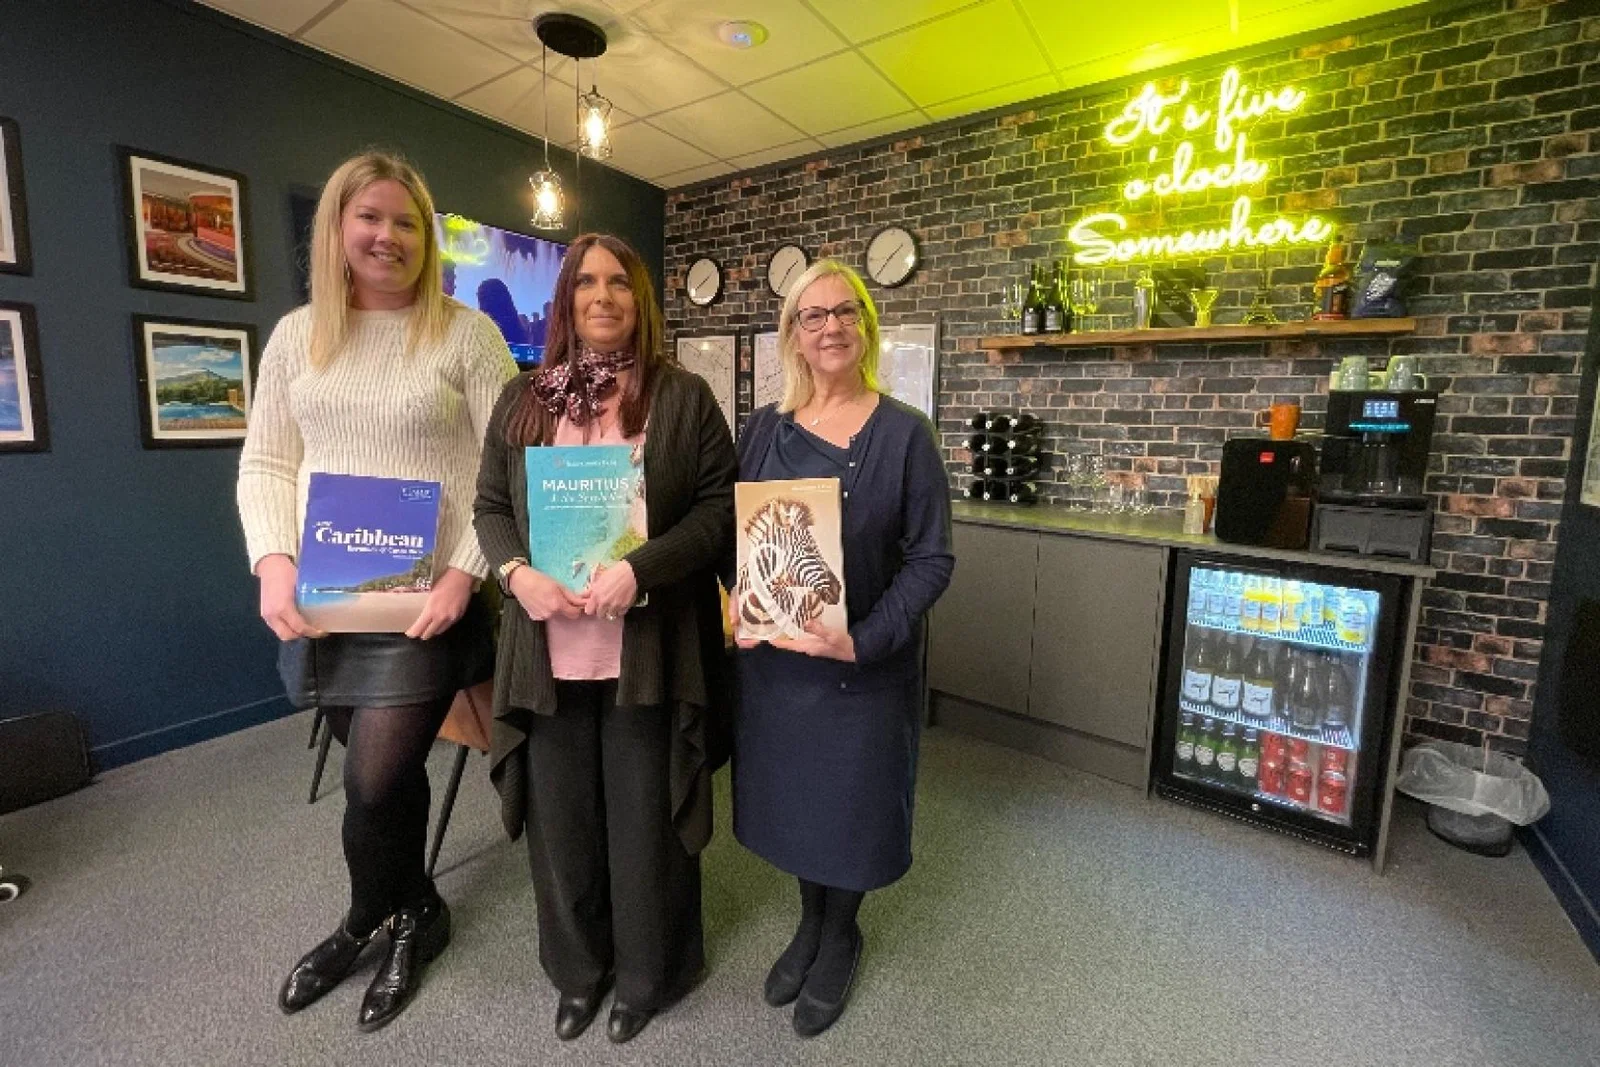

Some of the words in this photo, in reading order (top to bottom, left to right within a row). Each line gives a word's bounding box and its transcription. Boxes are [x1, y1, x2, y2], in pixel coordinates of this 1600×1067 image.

[1104, 80, 1210, 144] It's
[1214, 66, 1305, 152] five
[1123, 132, 1268, 200] o'clock
[1068, 196, 1332, 264] Somewhere
[542, 477, 630, 492] MAURITIUS
[315, 527, 424, 548] Caribbean
